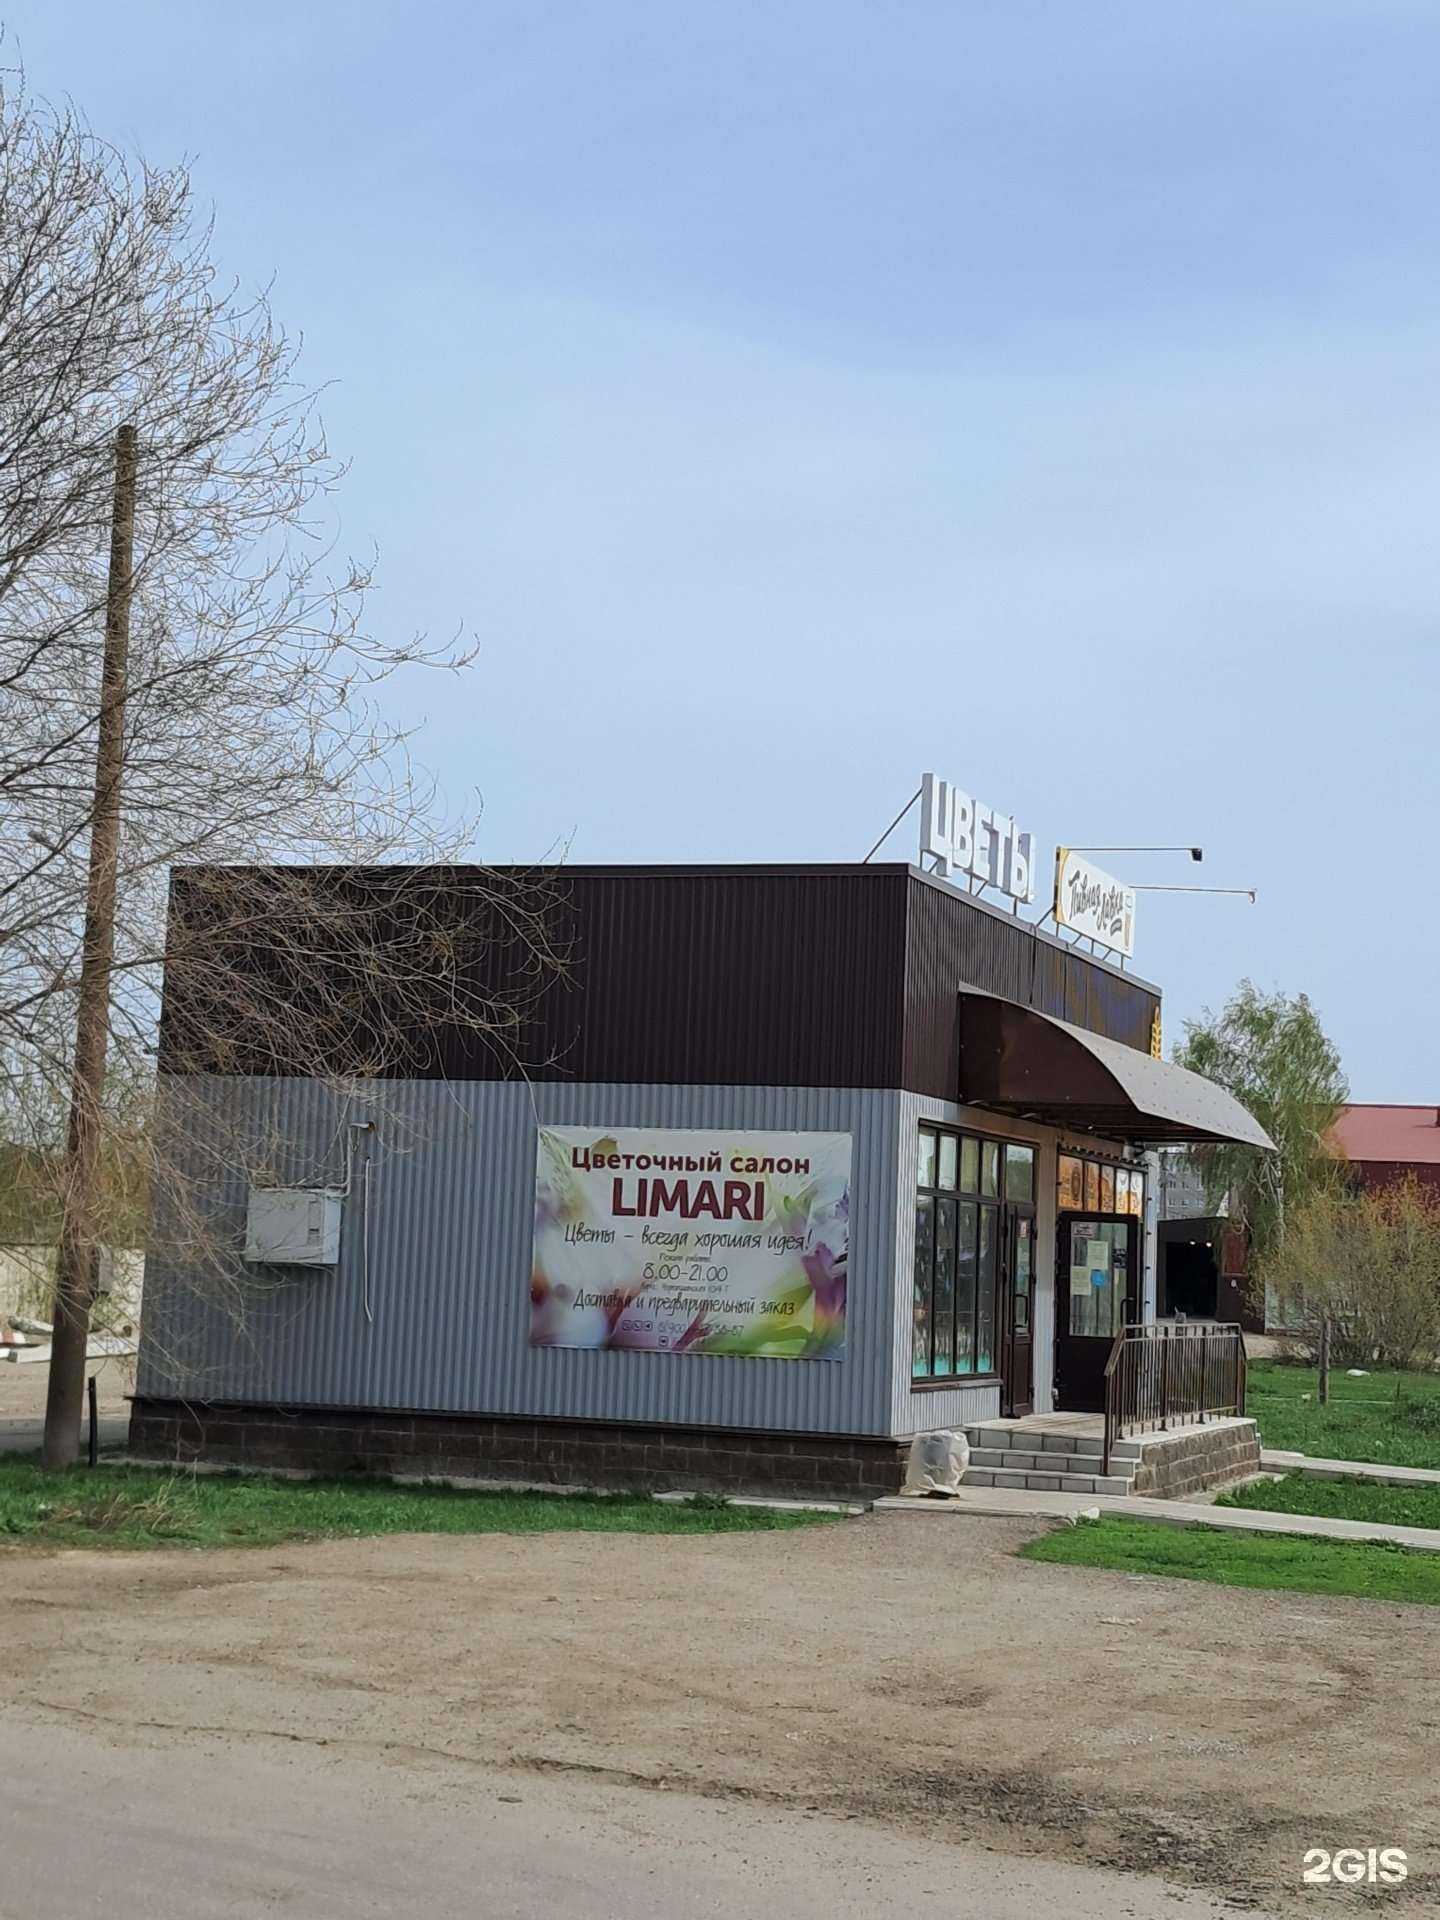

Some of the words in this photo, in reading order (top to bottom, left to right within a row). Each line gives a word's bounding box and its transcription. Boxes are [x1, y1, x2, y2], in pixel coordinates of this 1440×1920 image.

[919, 773, 1036, 905] ЦВЕТЫ
[572, 1146, 722, 1172] Цветочный
[730, 1156, 810, 1174] салон
[612, 1177, 765, 1220] LIMARI
[565, 1222, 616, 1246] Цветы
[641, 1224, 689, 1251] всегда
[695, 1232, 762, 1256] хорошая
[767, 1228, 813, 1256] идея!
[636, 1296, 646, 1310] и
[648, 1291, 755, 1318] предварительный
[759, 1300, 796, 1316] заказ
